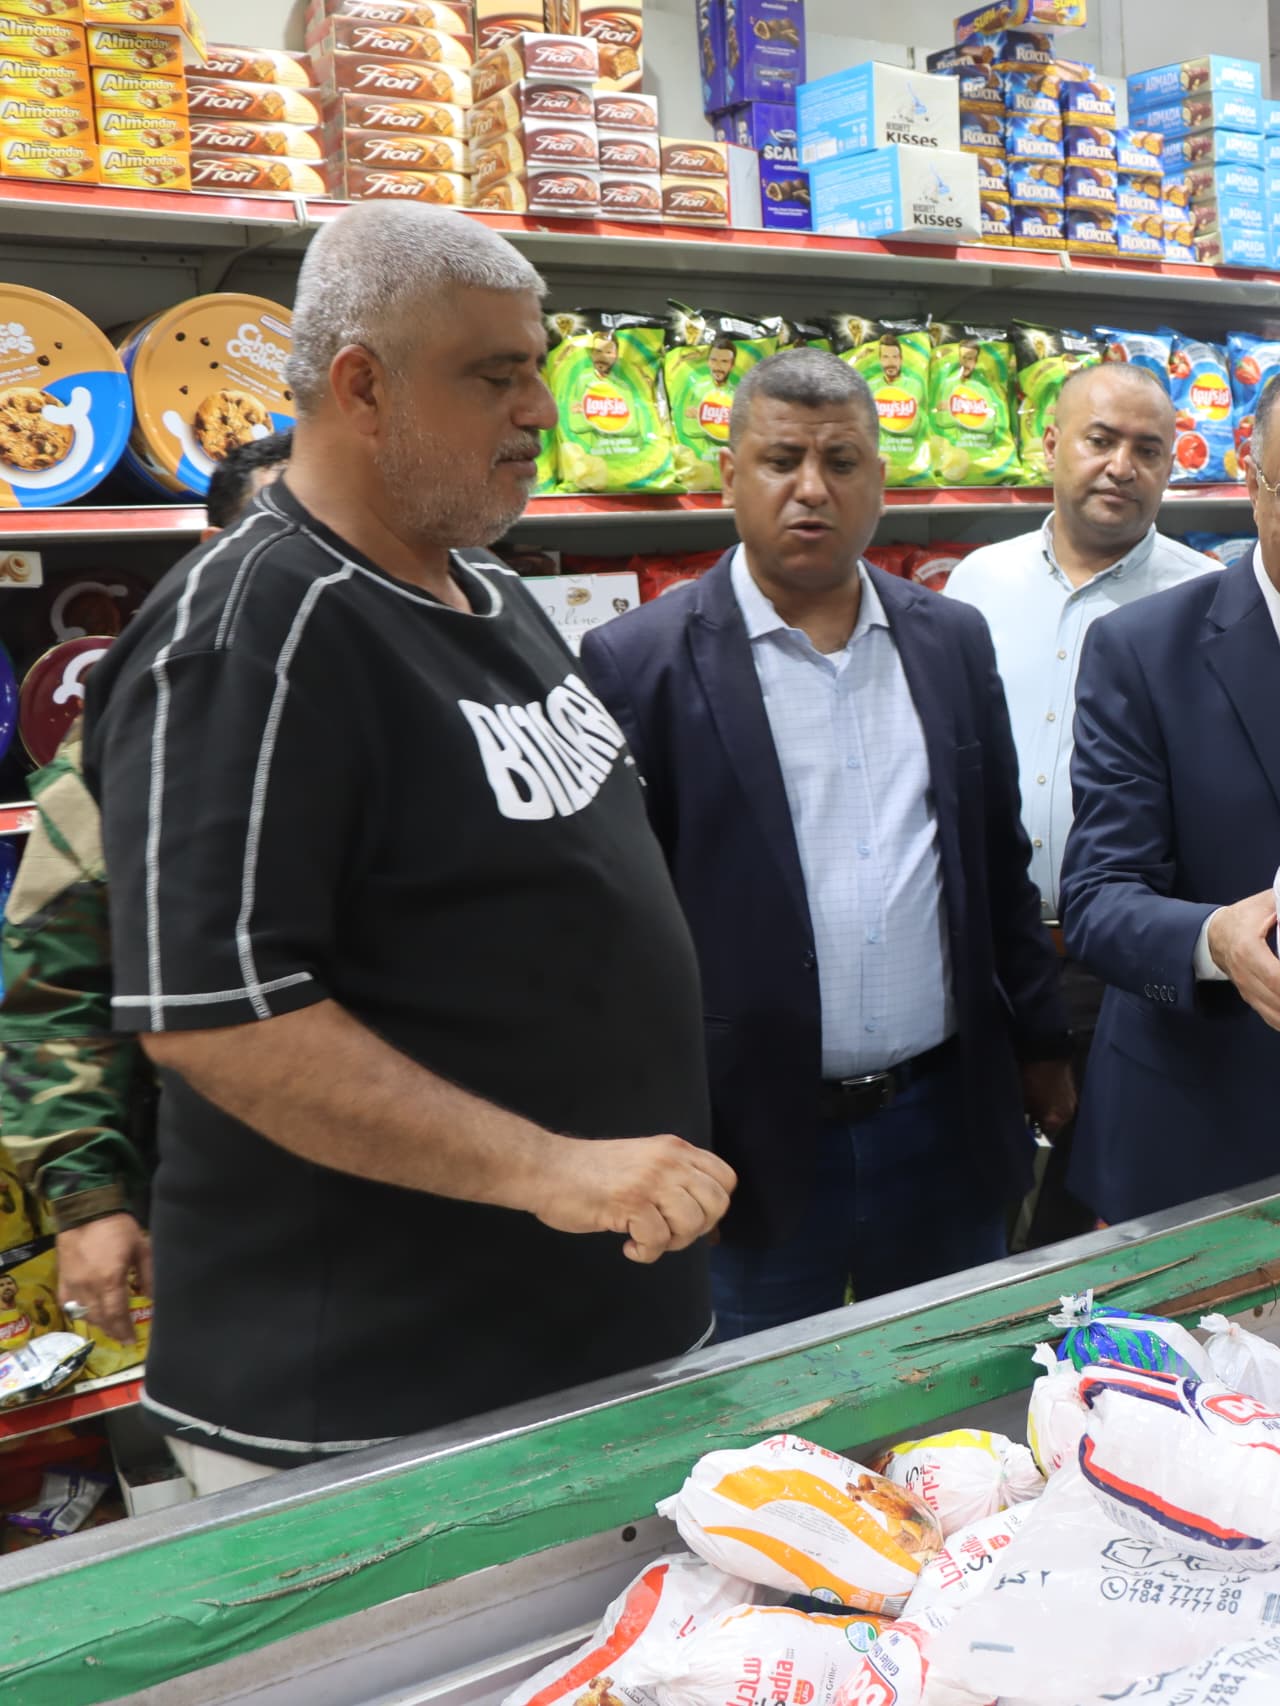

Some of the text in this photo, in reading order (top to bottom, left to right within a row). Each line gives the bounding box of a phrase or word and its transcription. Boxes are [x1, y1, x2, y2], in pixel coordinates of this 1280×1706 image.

[0, 20, 73, 37] Almonday
[584, 19, 634, 44] Fiori
[96, 31, 171, 50] Almonday
[353, 27, 410, 51] Fiori
[536, 47, 574, 63] Fiori
[1, 59, 76, 78] Almonday
[355, 64, 420, 90] Fiori
[102, 73, 175, 92] Almonday
[187, 86, 251, 111] Fiori
[531, 91, 570, 108] Fiori
[2, 100, 80, 119] Almonday
[364, 105, 424, 127] Fiori
[598, 103, 634, 119] Fiori
[104, 112, 177, 130] Almonday
[189, 123, 252, 147] Fiori
[536, 135, 574, 151] Fiori
[8, 142, 85, 159] Almonday
[105, 150, 177, 168] Almonday
[363, 139, 425, 161] Fiori
[601, 145, 637, 161] Fiori
[669, 151, 704, 167] Fiori
[192, 158, 256, 184] Fiori
[363, 173, 426, 196] Fiori
[539, 177, 577, 195] Fiori
[602, 187, 638, 203] Fiori
[671, 191, 705, 207] Fiori
[1132, 1578, 1165, 1593] 784
[1220, 1588, 1242, 1600] 50
[1128, 1588, 1239, 1614] 784 7777 60
